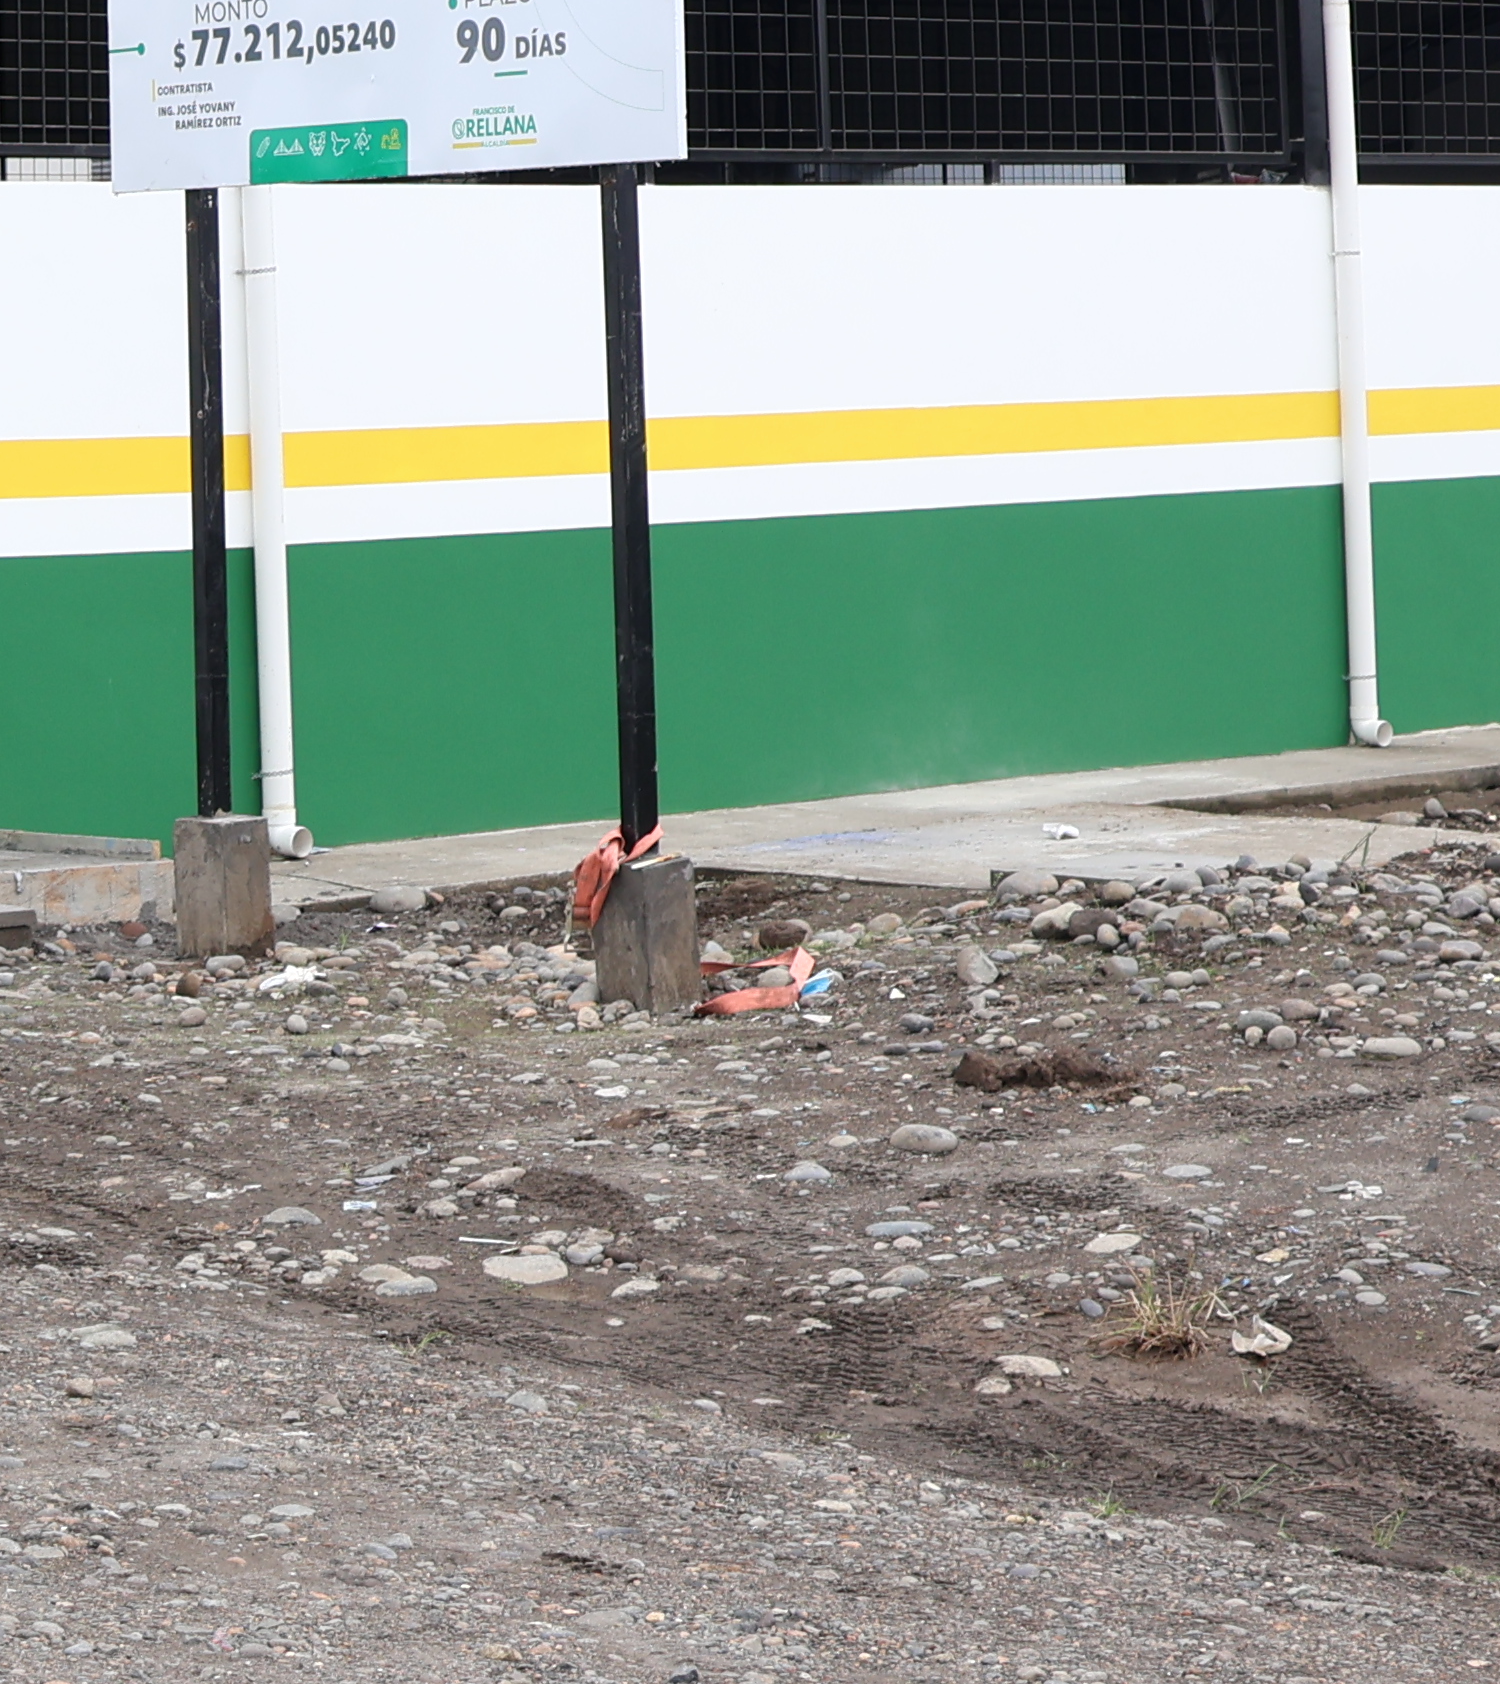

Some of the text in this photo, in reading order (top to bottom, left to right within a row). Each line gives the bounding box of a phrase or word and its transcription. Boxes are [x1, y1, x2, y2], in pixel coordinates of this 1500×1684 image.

[174, 19, 396, 72] $ 77.212,05240
[456, 17, 566, 64] 90 DÍAS
[157, 82, 213, 96] CONTRATISTA
[158, 100, 236, 117] ING. JOSÉ YOVANY
[472, 105, 515, 115] FRANCISCO DE
[175, 116, 242, 130] RAMÍREZ ORTIZ
